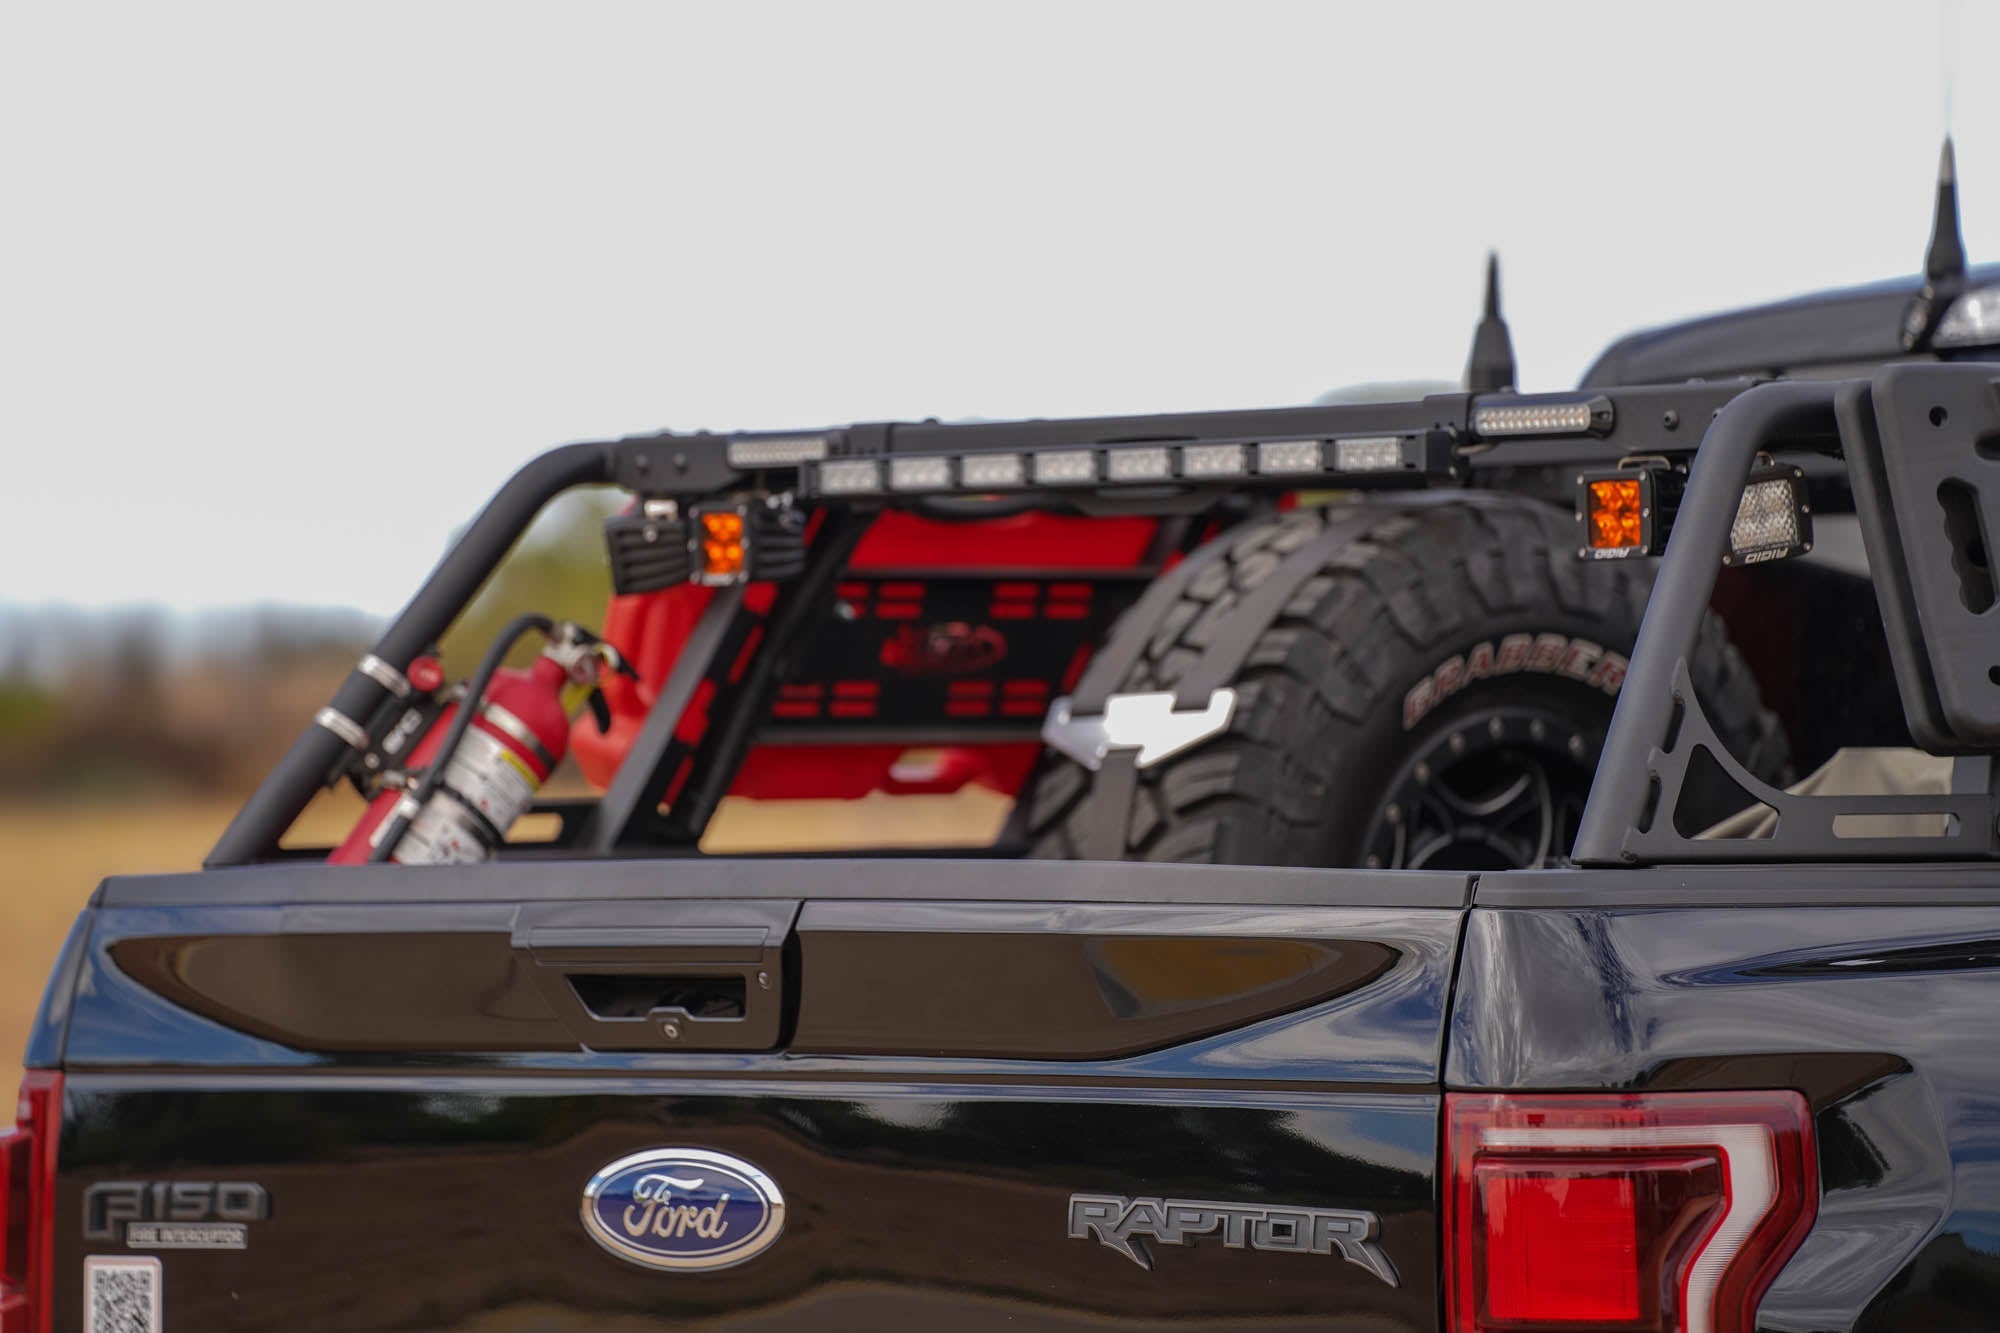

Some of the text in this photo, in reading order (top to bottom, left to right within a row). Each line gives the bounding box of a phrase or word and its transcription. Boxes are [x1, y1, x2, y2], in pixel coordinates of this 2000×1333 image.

[1744, 547, 1789, 564] RIGID
[1403, 632, 1630, 731] GRABBER
[623, 1174, 730, 1239] Ford
[1067, 1193, 1399, 1288] RAPTOR
